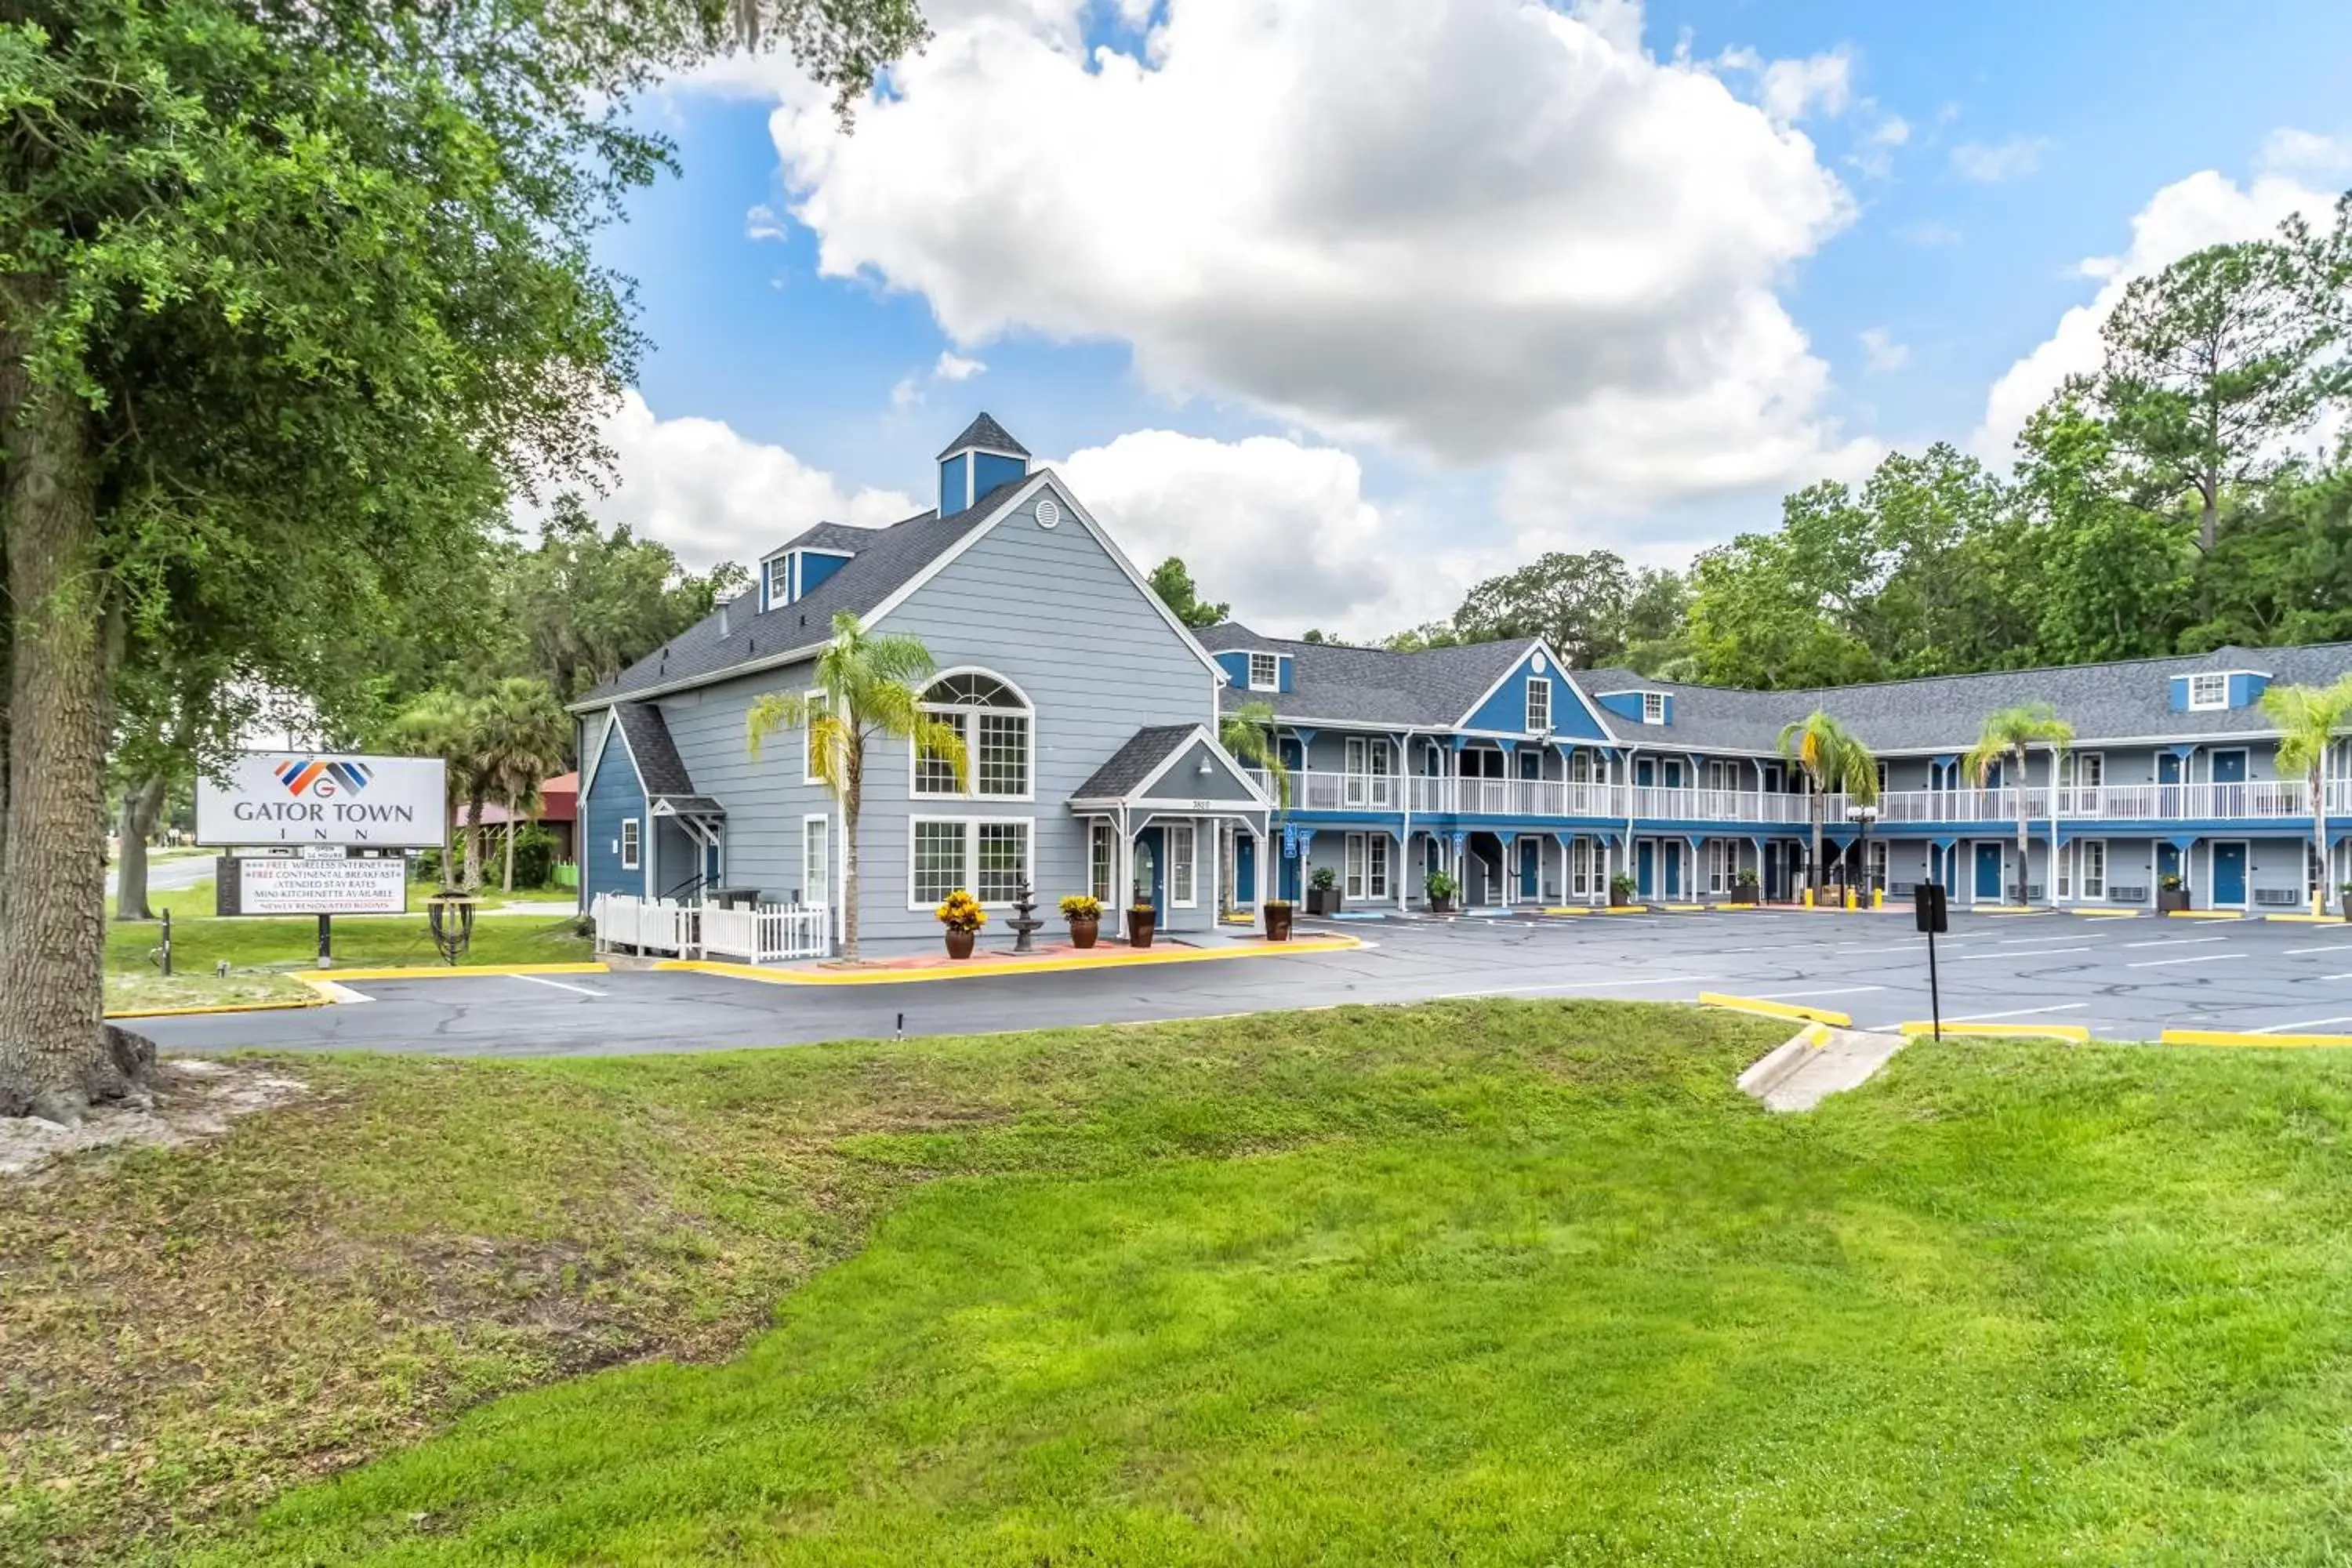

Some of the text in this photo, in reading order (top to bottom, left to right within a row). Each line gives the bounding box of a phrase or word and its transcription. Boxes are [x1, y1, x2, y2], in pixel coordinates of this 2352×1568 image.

[234, 801, 413, 823] GATOR TOWN
[281, 828, 368, 840] INN
[338, 862, 382, 870] INTERNET
